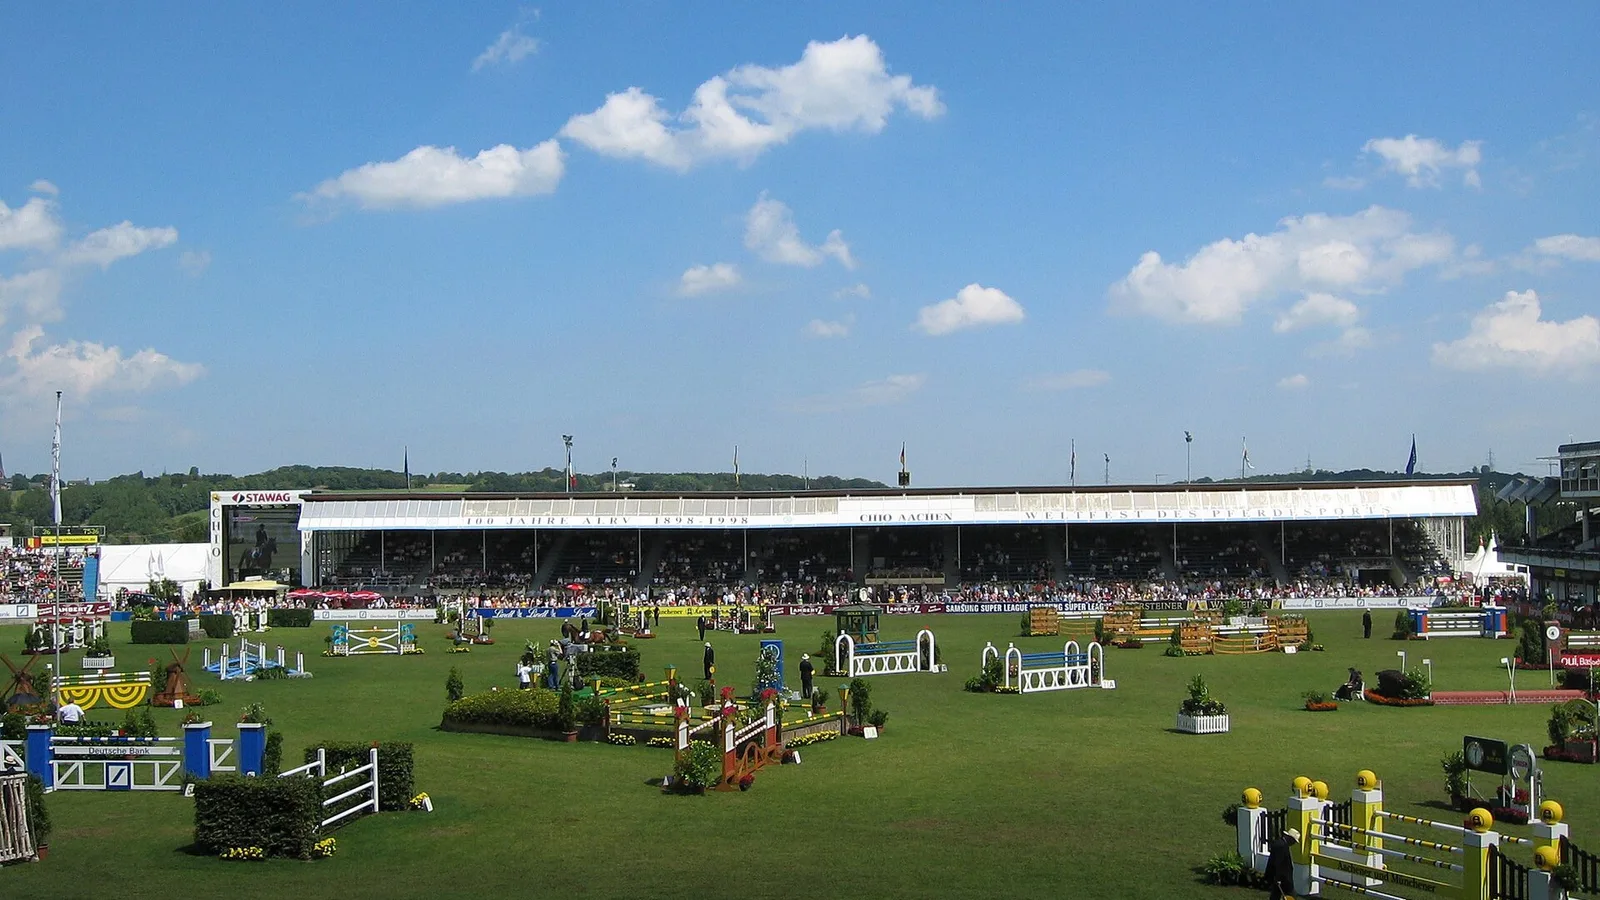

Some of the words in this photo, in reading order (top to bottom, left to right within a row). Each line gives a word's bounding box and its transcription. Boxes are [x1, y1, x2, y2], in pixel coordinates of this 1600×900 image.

[246, 493, 290, 502] STAWAG
[860, 514, 892, 522] CHIO
[899, 512, 952, 520] AACHEN
[1026, 510, 1143, 520] WELTFEST
[1158, 510, 1197, 518] DES
[1212, 507, 1391, 518] PFERDESPORTS
[212, 508, 220, 557] CHIO
[790, 606, 824, 614] LAMBERTZ
[886, 605, 922, 614] LAMBERTZ
[946, 604, 978, 612] SAMSUNG
[980, 603, 1002, 612] SUPER
[1004, 602, 1028, 612] LEAGUE
[1065, 602, 1087, 611] SUPER
[492, 609, 518, 618] Lindt
[526, 609, 550, 618] Lindt
[571, 608, 594, 618] Lindt
[1338, 862, 1373, 876] Aachener
[1374, 871, 1388, 881] und
